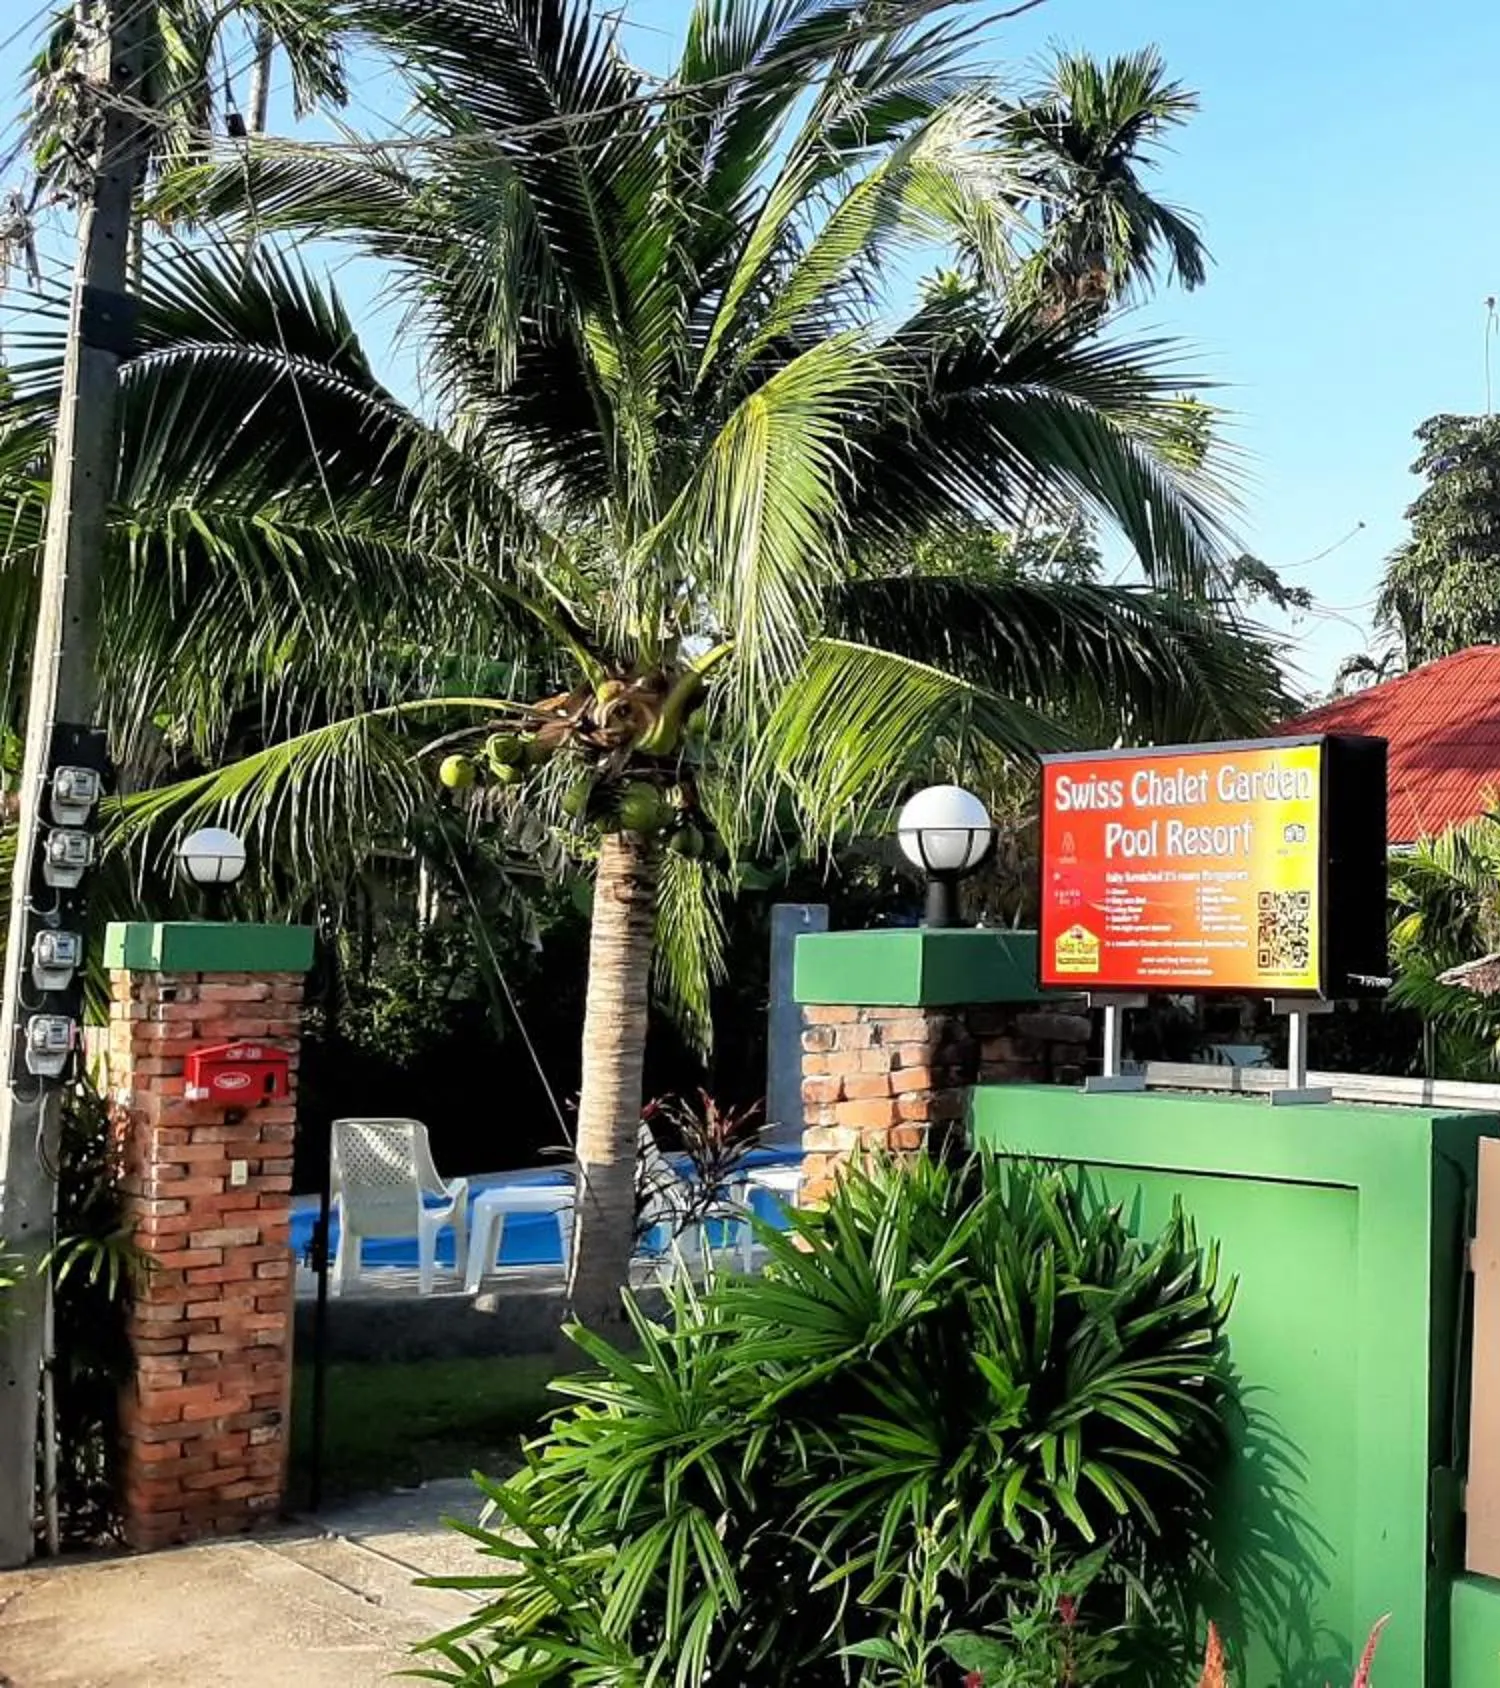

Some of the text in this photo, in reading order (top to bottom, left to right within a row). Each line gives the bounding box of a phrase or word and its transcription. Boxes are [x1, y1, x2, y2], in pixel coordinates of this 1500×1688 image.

[1055, 761, 1313, 811] Swiss Chalet Garden
[1105, 817, 1253, 860] Pool Resort
